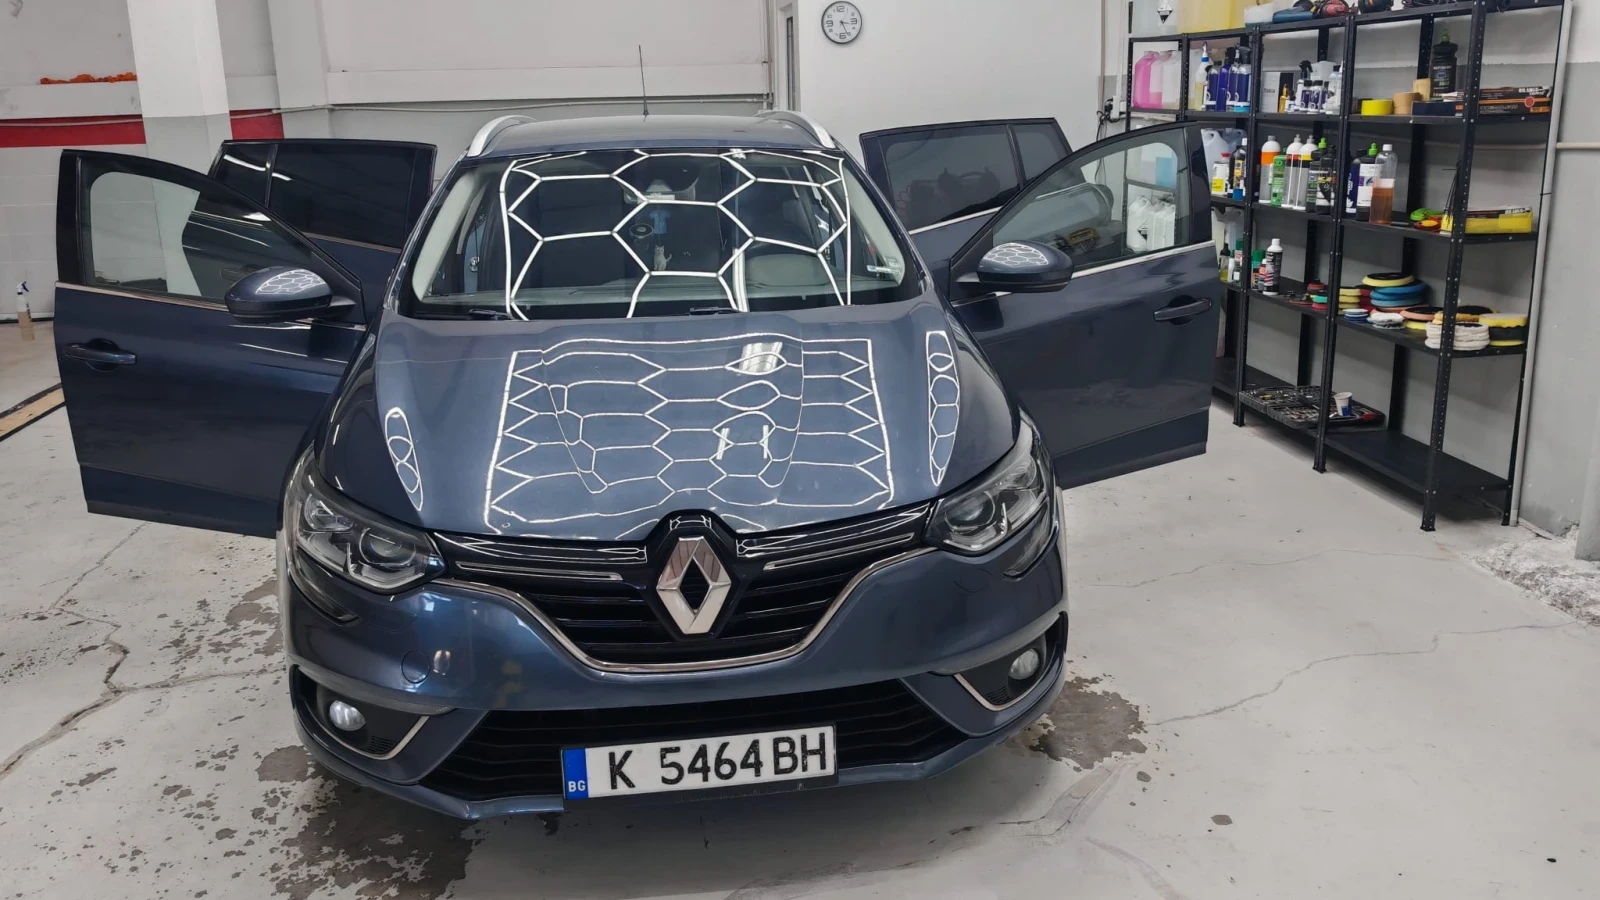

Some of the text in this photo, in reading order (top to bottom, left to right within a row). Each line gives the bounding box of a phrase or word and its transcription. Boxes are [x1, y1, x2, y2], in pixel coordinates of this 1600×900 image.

[608, 732, 827, 790] K 5464 BH
[568, 780, 586, 793] BG
